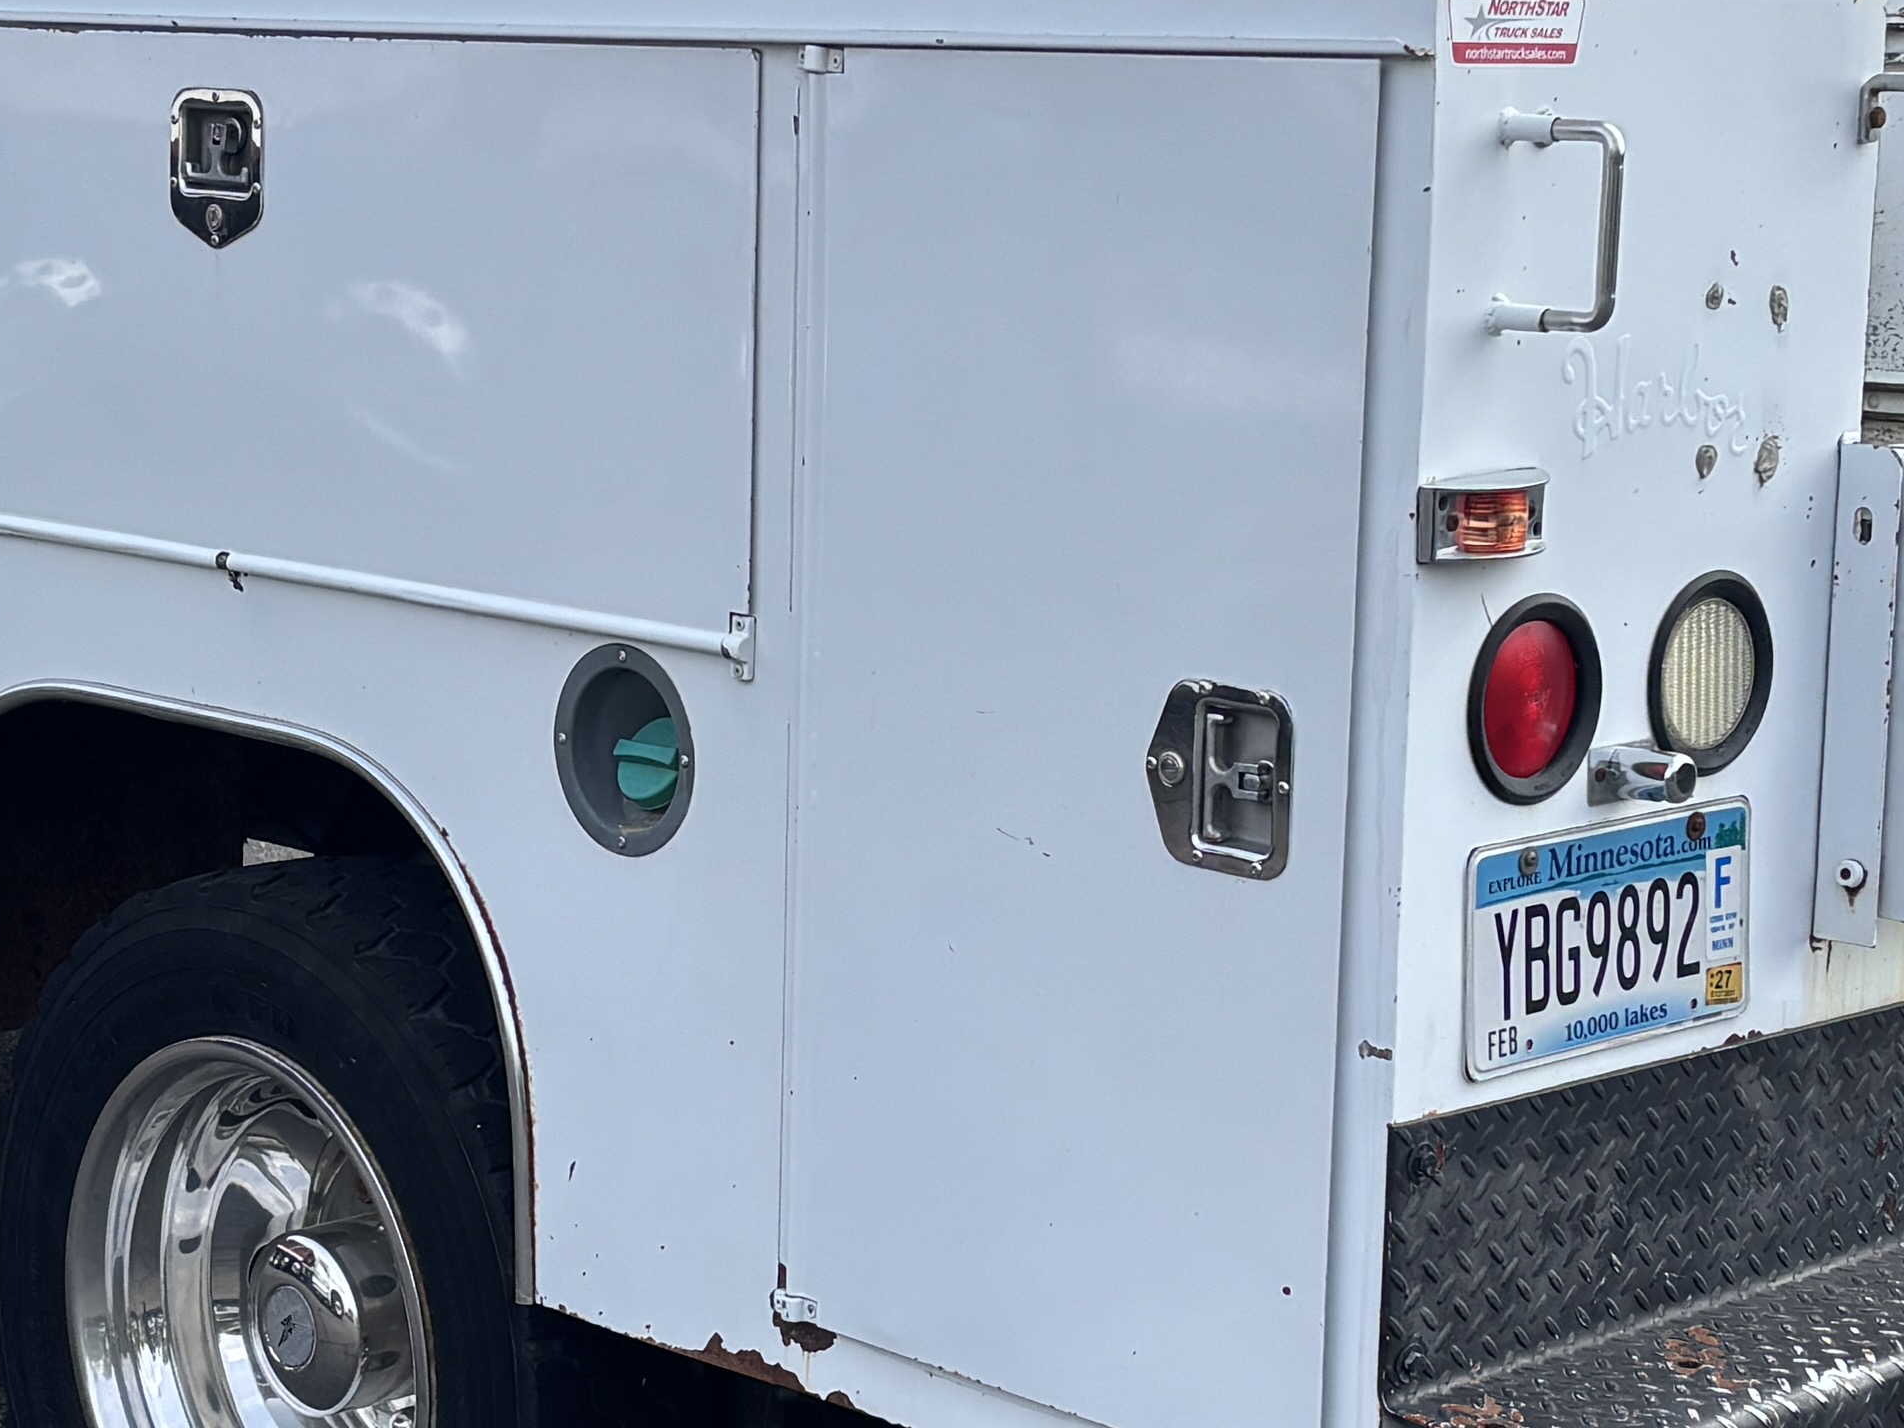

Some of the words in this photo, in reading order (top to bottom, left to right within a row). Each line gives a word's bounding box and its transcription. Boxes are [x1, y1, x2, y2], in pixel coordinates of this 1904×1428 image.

[1494, 27, 1529, 39] TRUCK
[1530, 28, 1564, 39] SALES
[1465, 46, 1567, 60] northstartrucksales.com
[1488, 872, 1542, 895] EXPLORE
[1714, 856, 1732, 909] F
[1493, 871, 1701, 1022] YBG9892
[1488, 1026, 1518, 1061] FEB
[1564, 1011, 1620, 1043] 10,000
[1625, 1002, 1669, 1028] lakes
